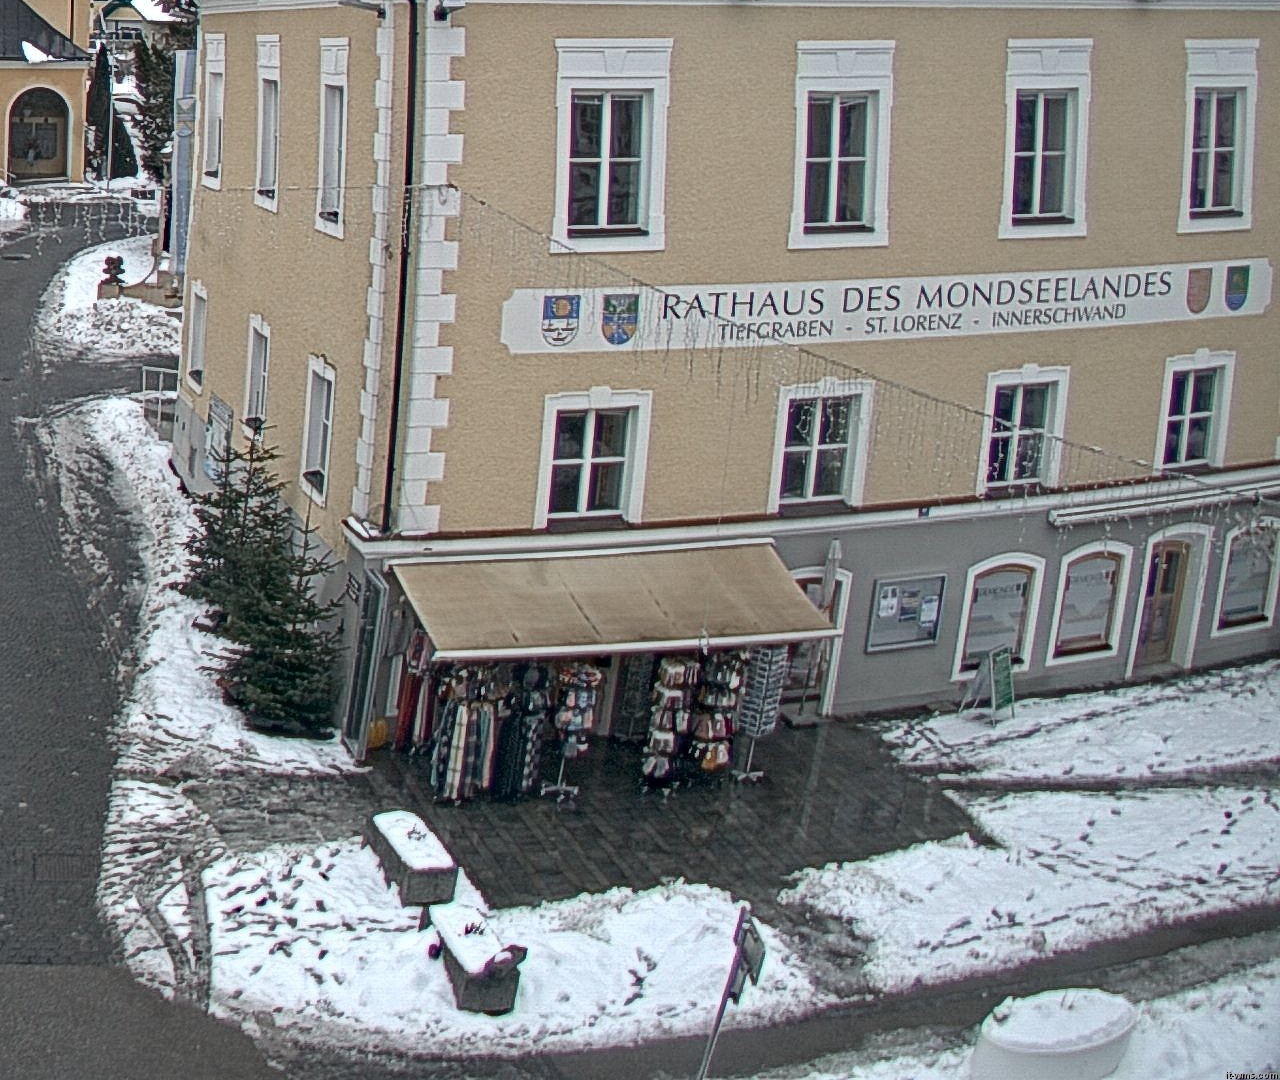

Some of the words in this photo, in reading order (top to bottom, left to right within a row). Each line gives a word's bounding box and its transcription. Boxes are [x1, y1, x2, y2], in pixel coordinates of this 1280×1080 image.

[663, 288, 824, 319] RATHAUS
[842, 285, 901, 313] DES
[917, 271, 1172, 309] MONDSEELANDES
[719, 320, 833, 340] TIEFGRABEN
[893, 313, 962, 332] LORENZ
[992, 304, 1126, 327] INNERSCHWAND
